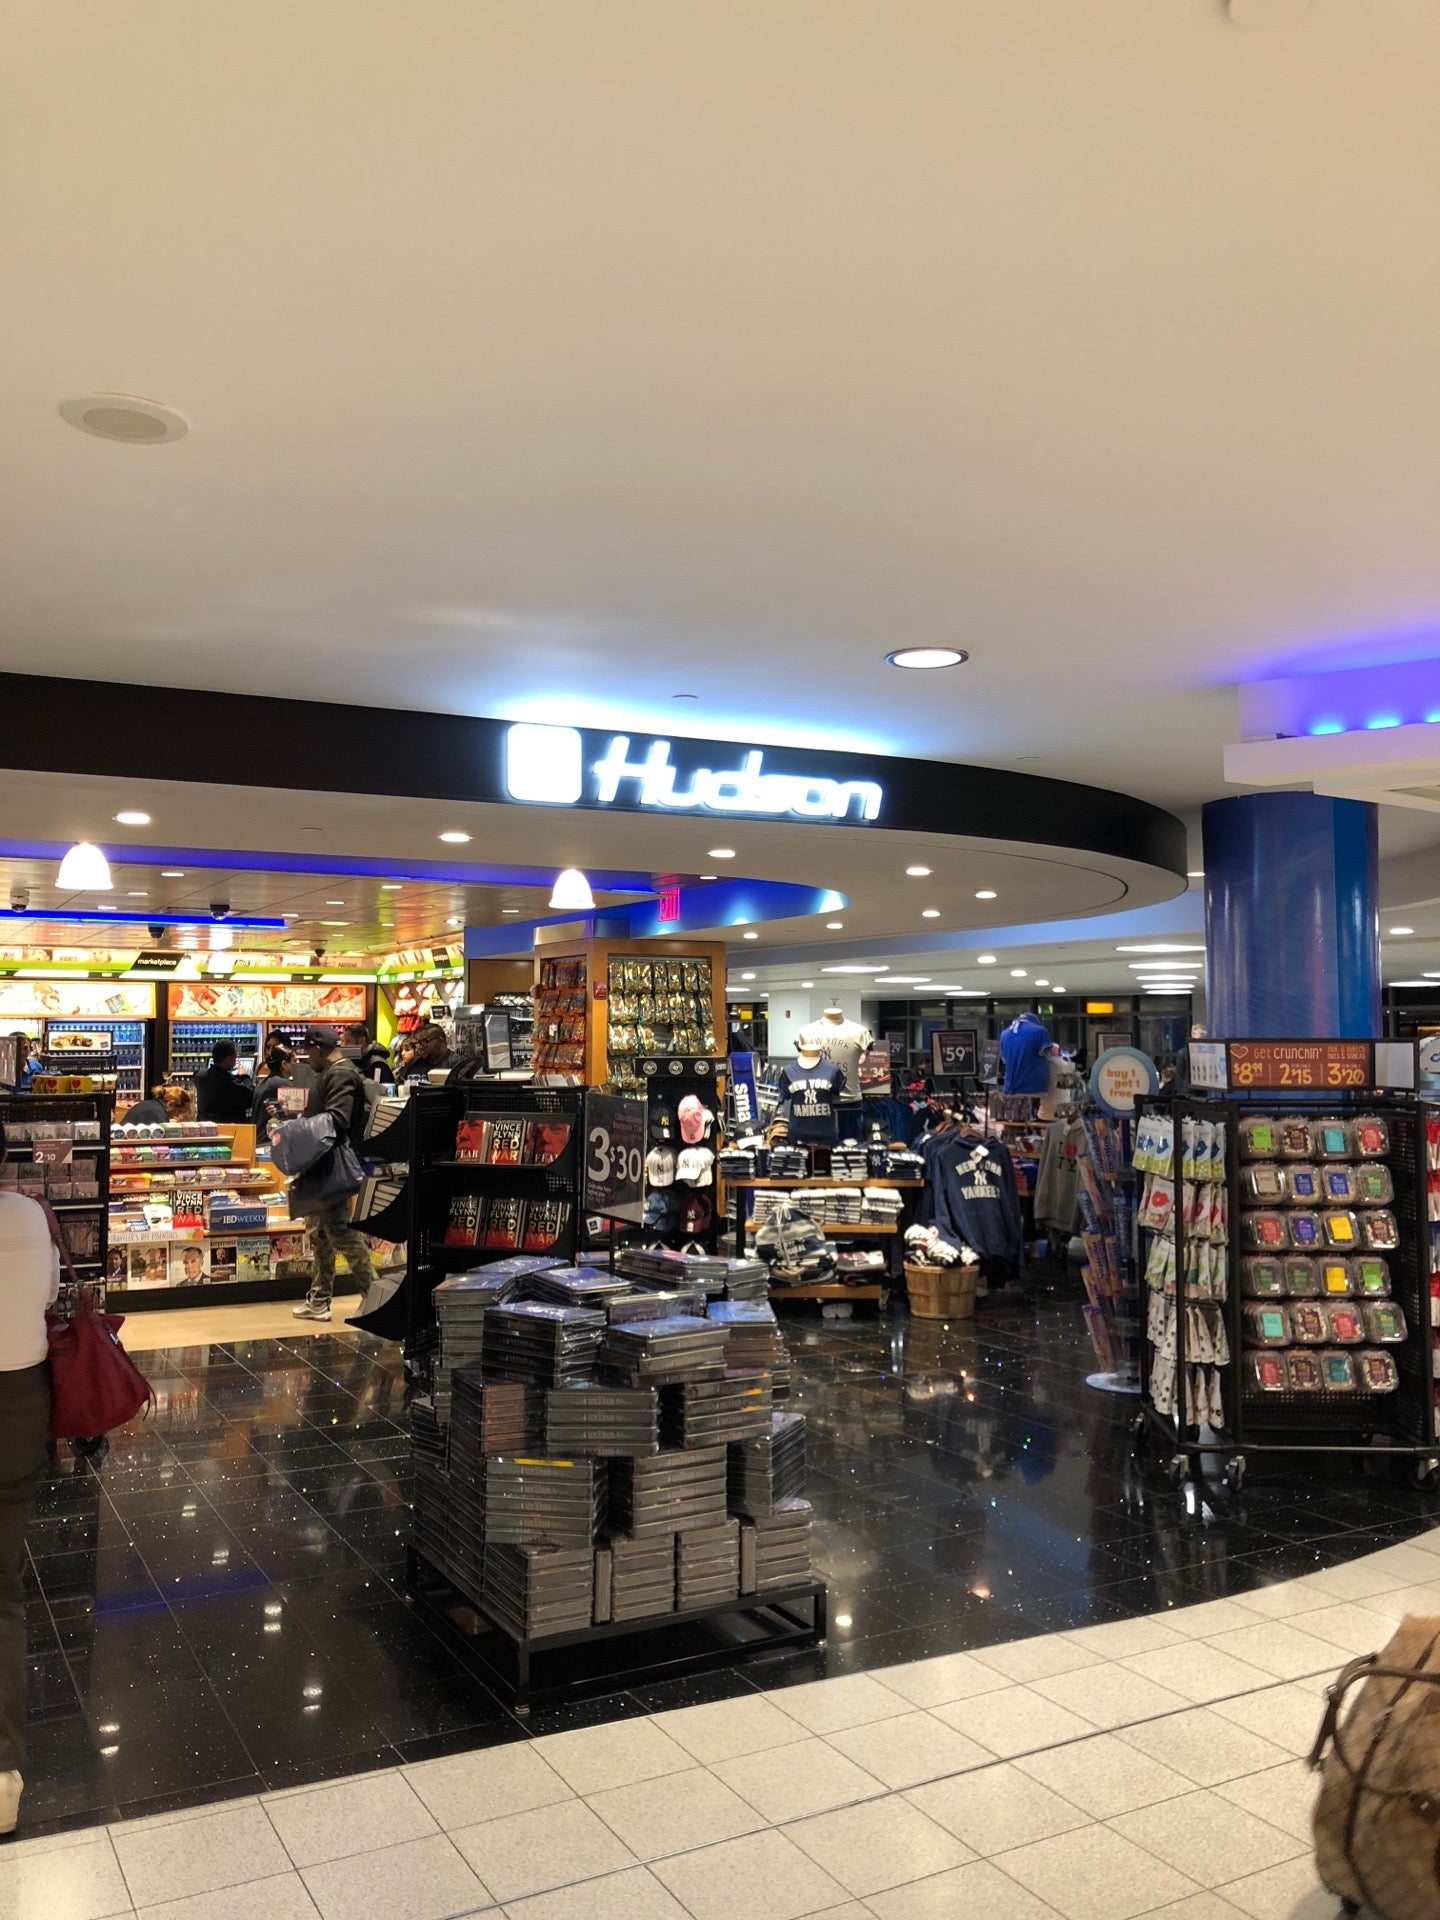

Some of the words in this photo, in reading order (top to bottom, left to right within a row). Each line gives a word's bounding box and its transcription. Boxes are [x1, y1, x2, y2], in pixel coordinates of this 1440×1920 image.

[593, 736, 883, 820] Hudson
[137, 958, 177, 966] marketplace
[1107, 1068, 1128, 1079] buy
[1132, 1069, 1136, 1077] 1
[1280, 1063, 1292, 1085] 2
[1328, 1063, 1342, 1085] 3
[1114, 1080, 1132, 1089] get
[1135, 1080, 1140, 1088] 1
[1109, 1089, 1132, 1098] free
[493, 1131, 520, 1139] FLYNN
[493, 1139, 520, 1150] RED
[35, 1151, 44, 1164] 2
[455, 1149, 479, 1159] FEAR
[490, 1150, 518, 1161] WAR
[588, 1127, 611, 1182] 3
[177, 1206, 202, 1214] RED
[451, 1201, 477, 1209] VINCE
[492, 1202, 518, 1211] VINCE
[530, 1205, 557, 1213] VINCE
[449, 1208, 477, 1216] FLYNN
[490, 1210, 518, 1218] FLYNN
[528, 1213, 556, 1221] FLYNN
[450, 1216, 475, 1228] RED
[490, 1219, 516, 1231] RED
[528, 1221, 555, 1233] RED
